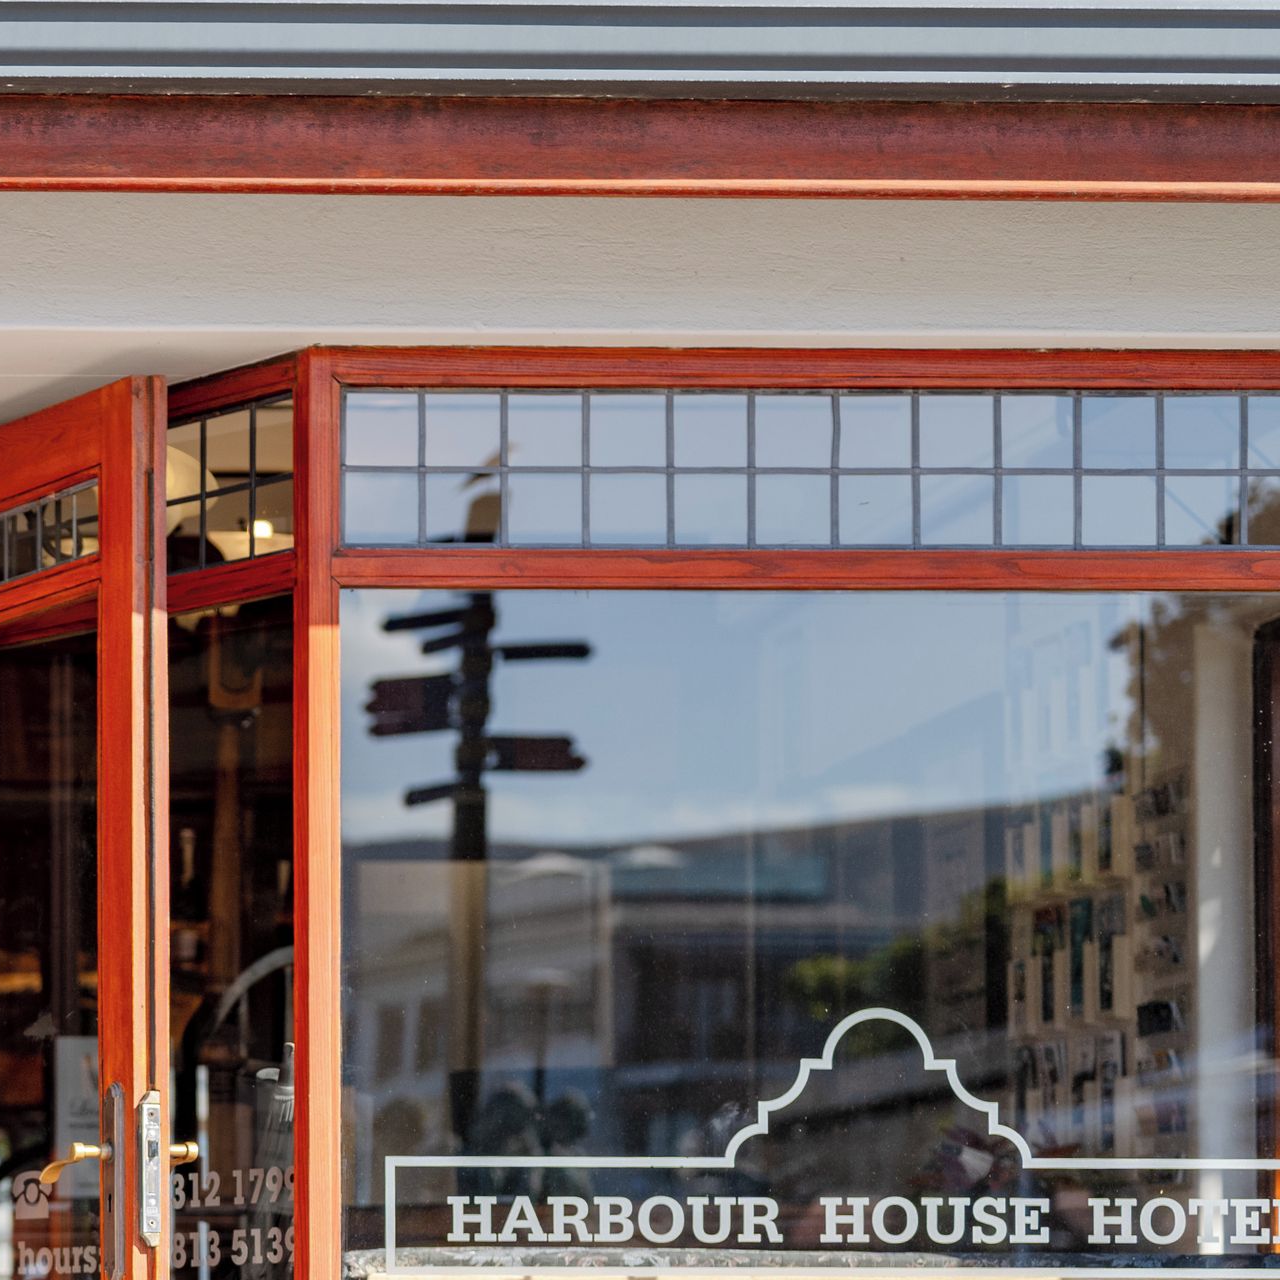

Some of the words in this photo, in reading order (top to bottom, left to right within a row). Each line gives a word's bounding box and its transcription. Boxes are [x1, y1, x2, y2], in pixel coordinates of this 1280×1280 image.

[447, 1195, 782, 1243] HARBOUR
[820, 1196, 1050, 1244] HOUSE
[1089, 1197, 1280, 1245] HOTE
